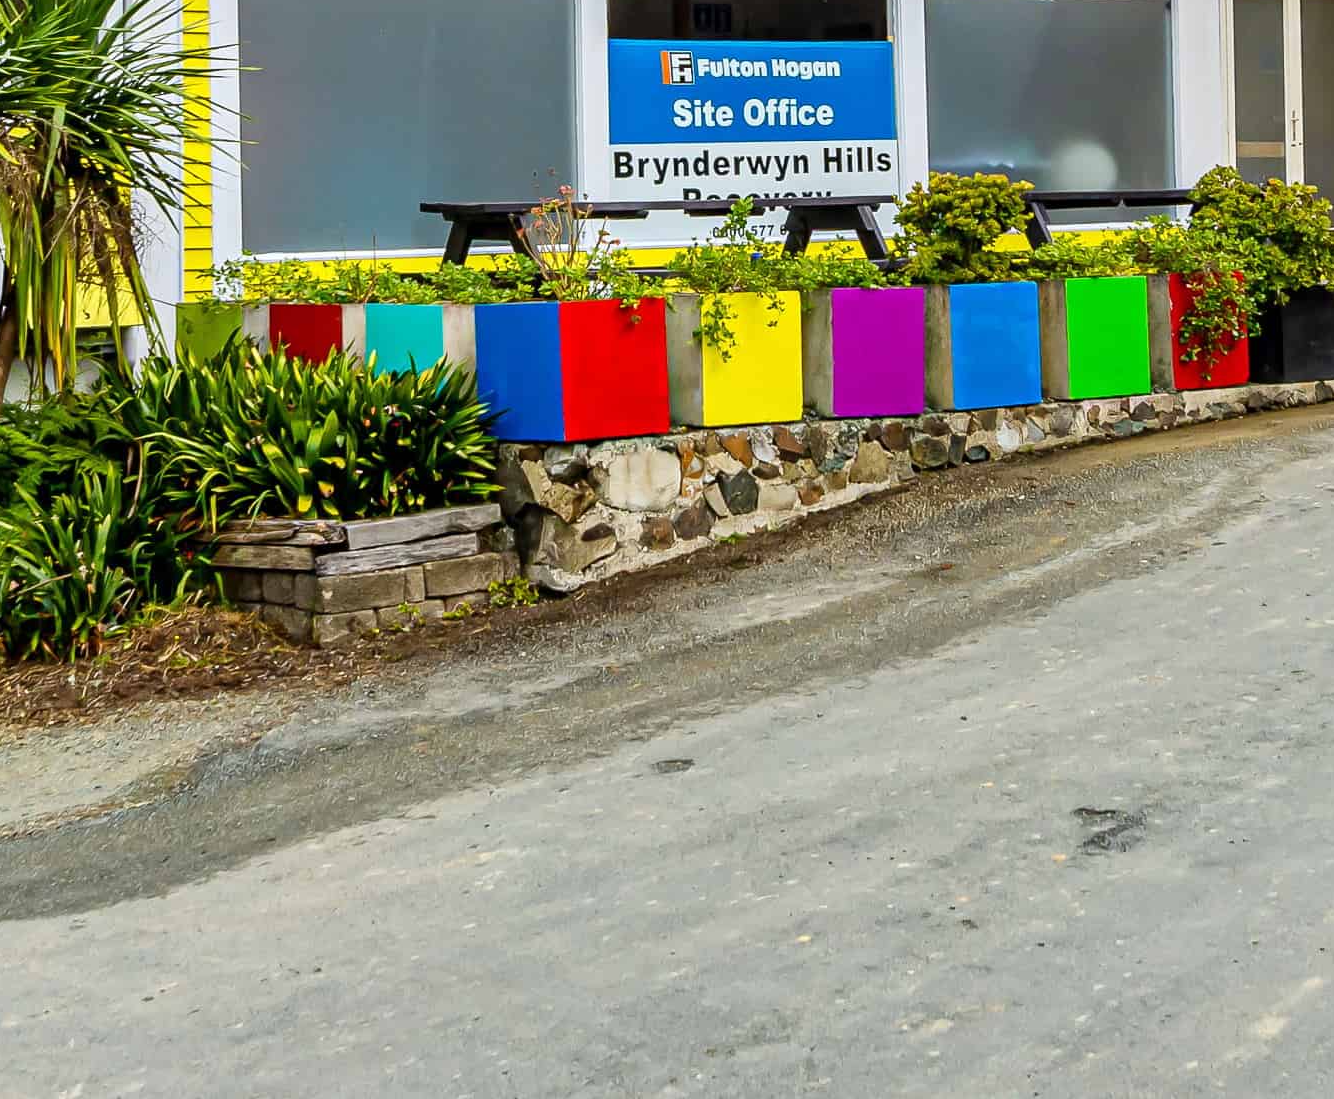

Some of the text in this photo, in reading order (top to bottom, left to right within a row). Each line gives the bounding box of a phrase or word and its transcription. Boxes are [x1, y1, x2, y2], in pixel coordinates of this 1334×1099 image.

[697, 57, 841, 81] Fulton Hogan
[672, 98, 835, 128] Site Office
[613, 147, 892, 185] Brynderwyn Hills
[751, 224, 775, 237] 577
